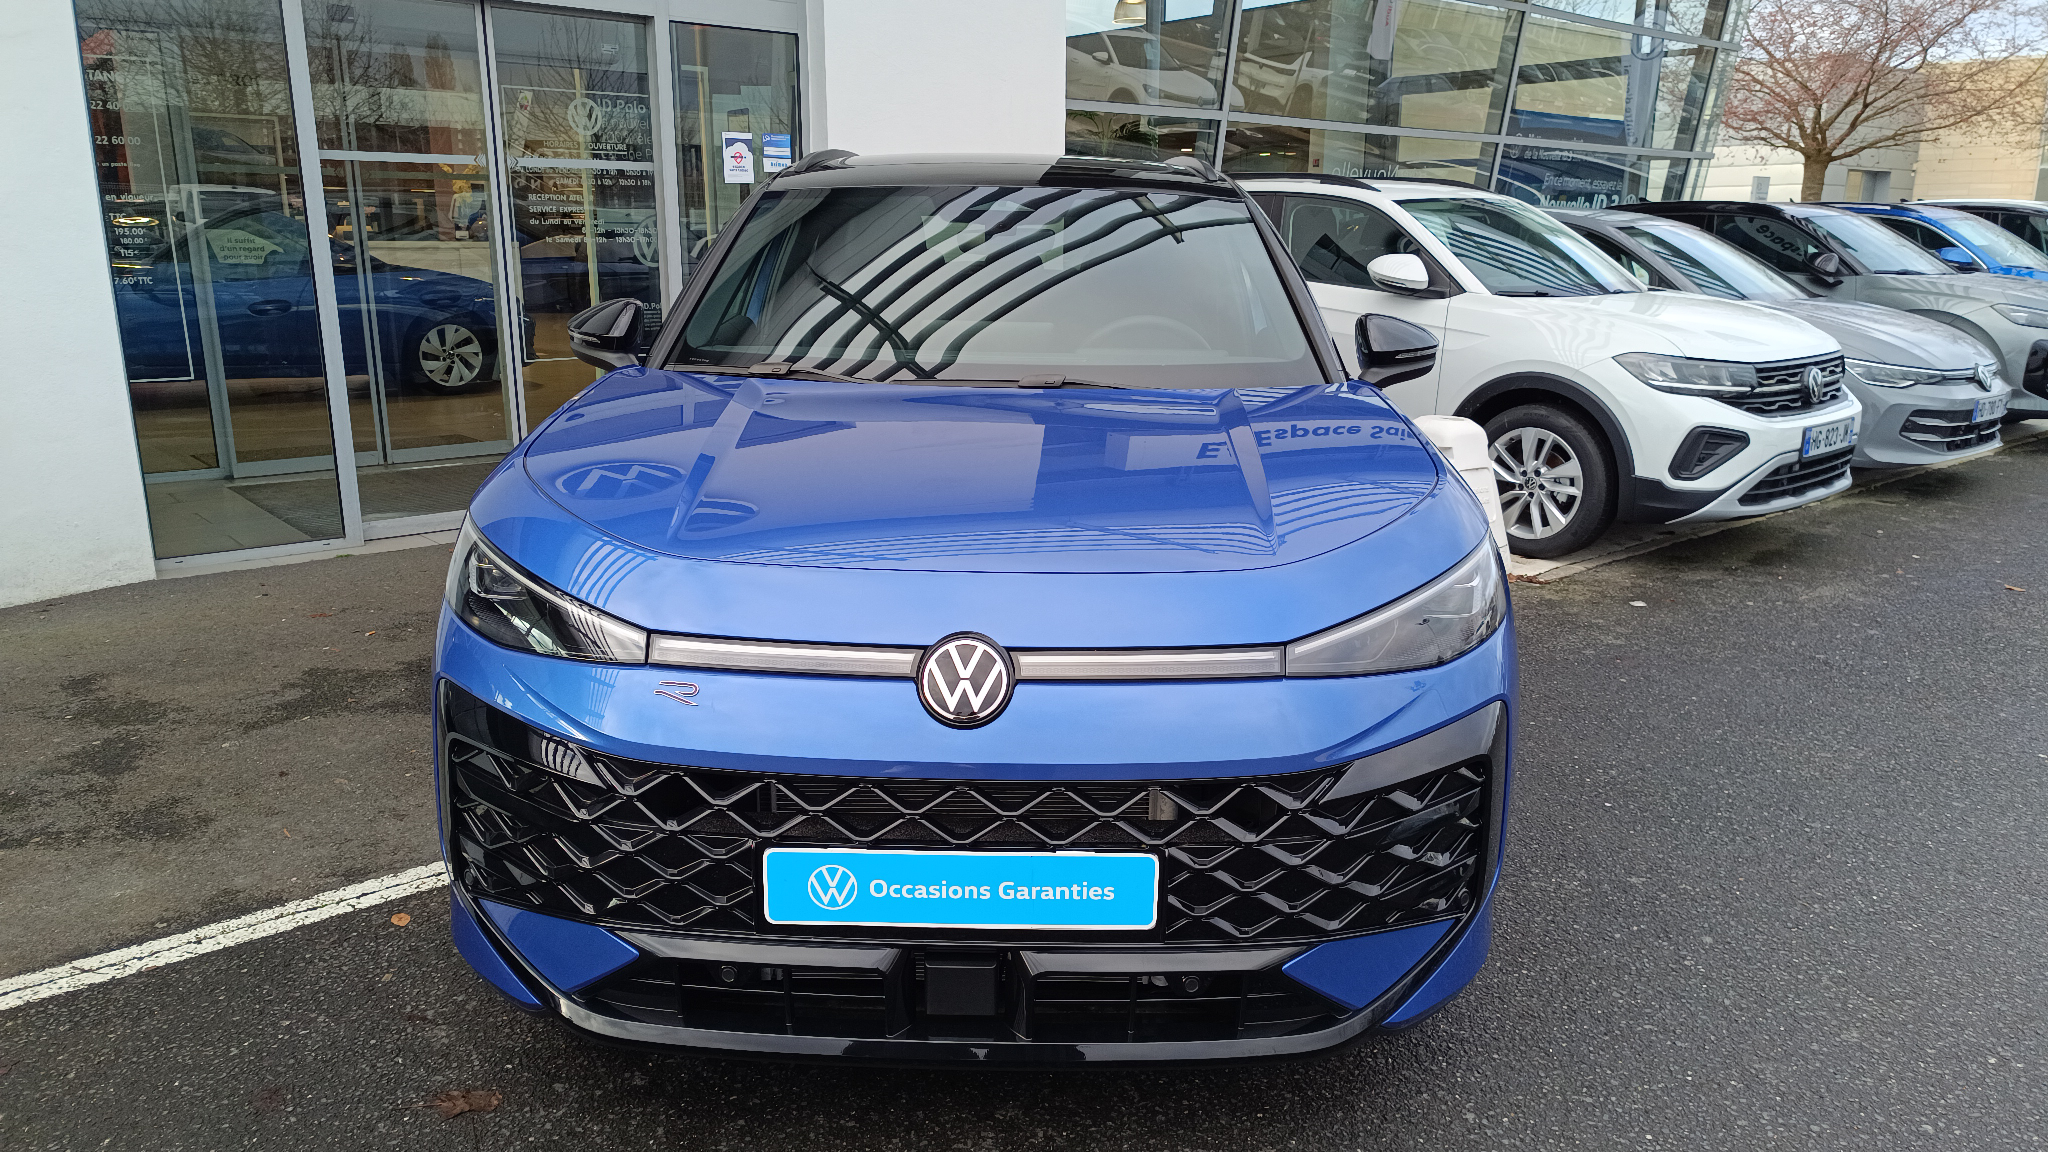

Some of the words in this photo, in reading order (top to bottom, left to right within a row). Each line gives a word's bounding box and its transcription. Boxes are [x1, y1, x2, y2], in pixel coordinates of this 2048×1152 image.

[94, 136, 109, 145] 22
[543, 140, 579, 149] HORAIRES
[584, 142, 628, 151] OUVERTURE
[528, 193, 566, 201] RECEPTION
[569, 194, 594, 202] ATELR
[529, 205, 557, 213] SERVICE
[541, 217, 561, 225] Lundi
[869, 879, 991, 901] Occasions
[998, 880, 1115, 903] Garanties
